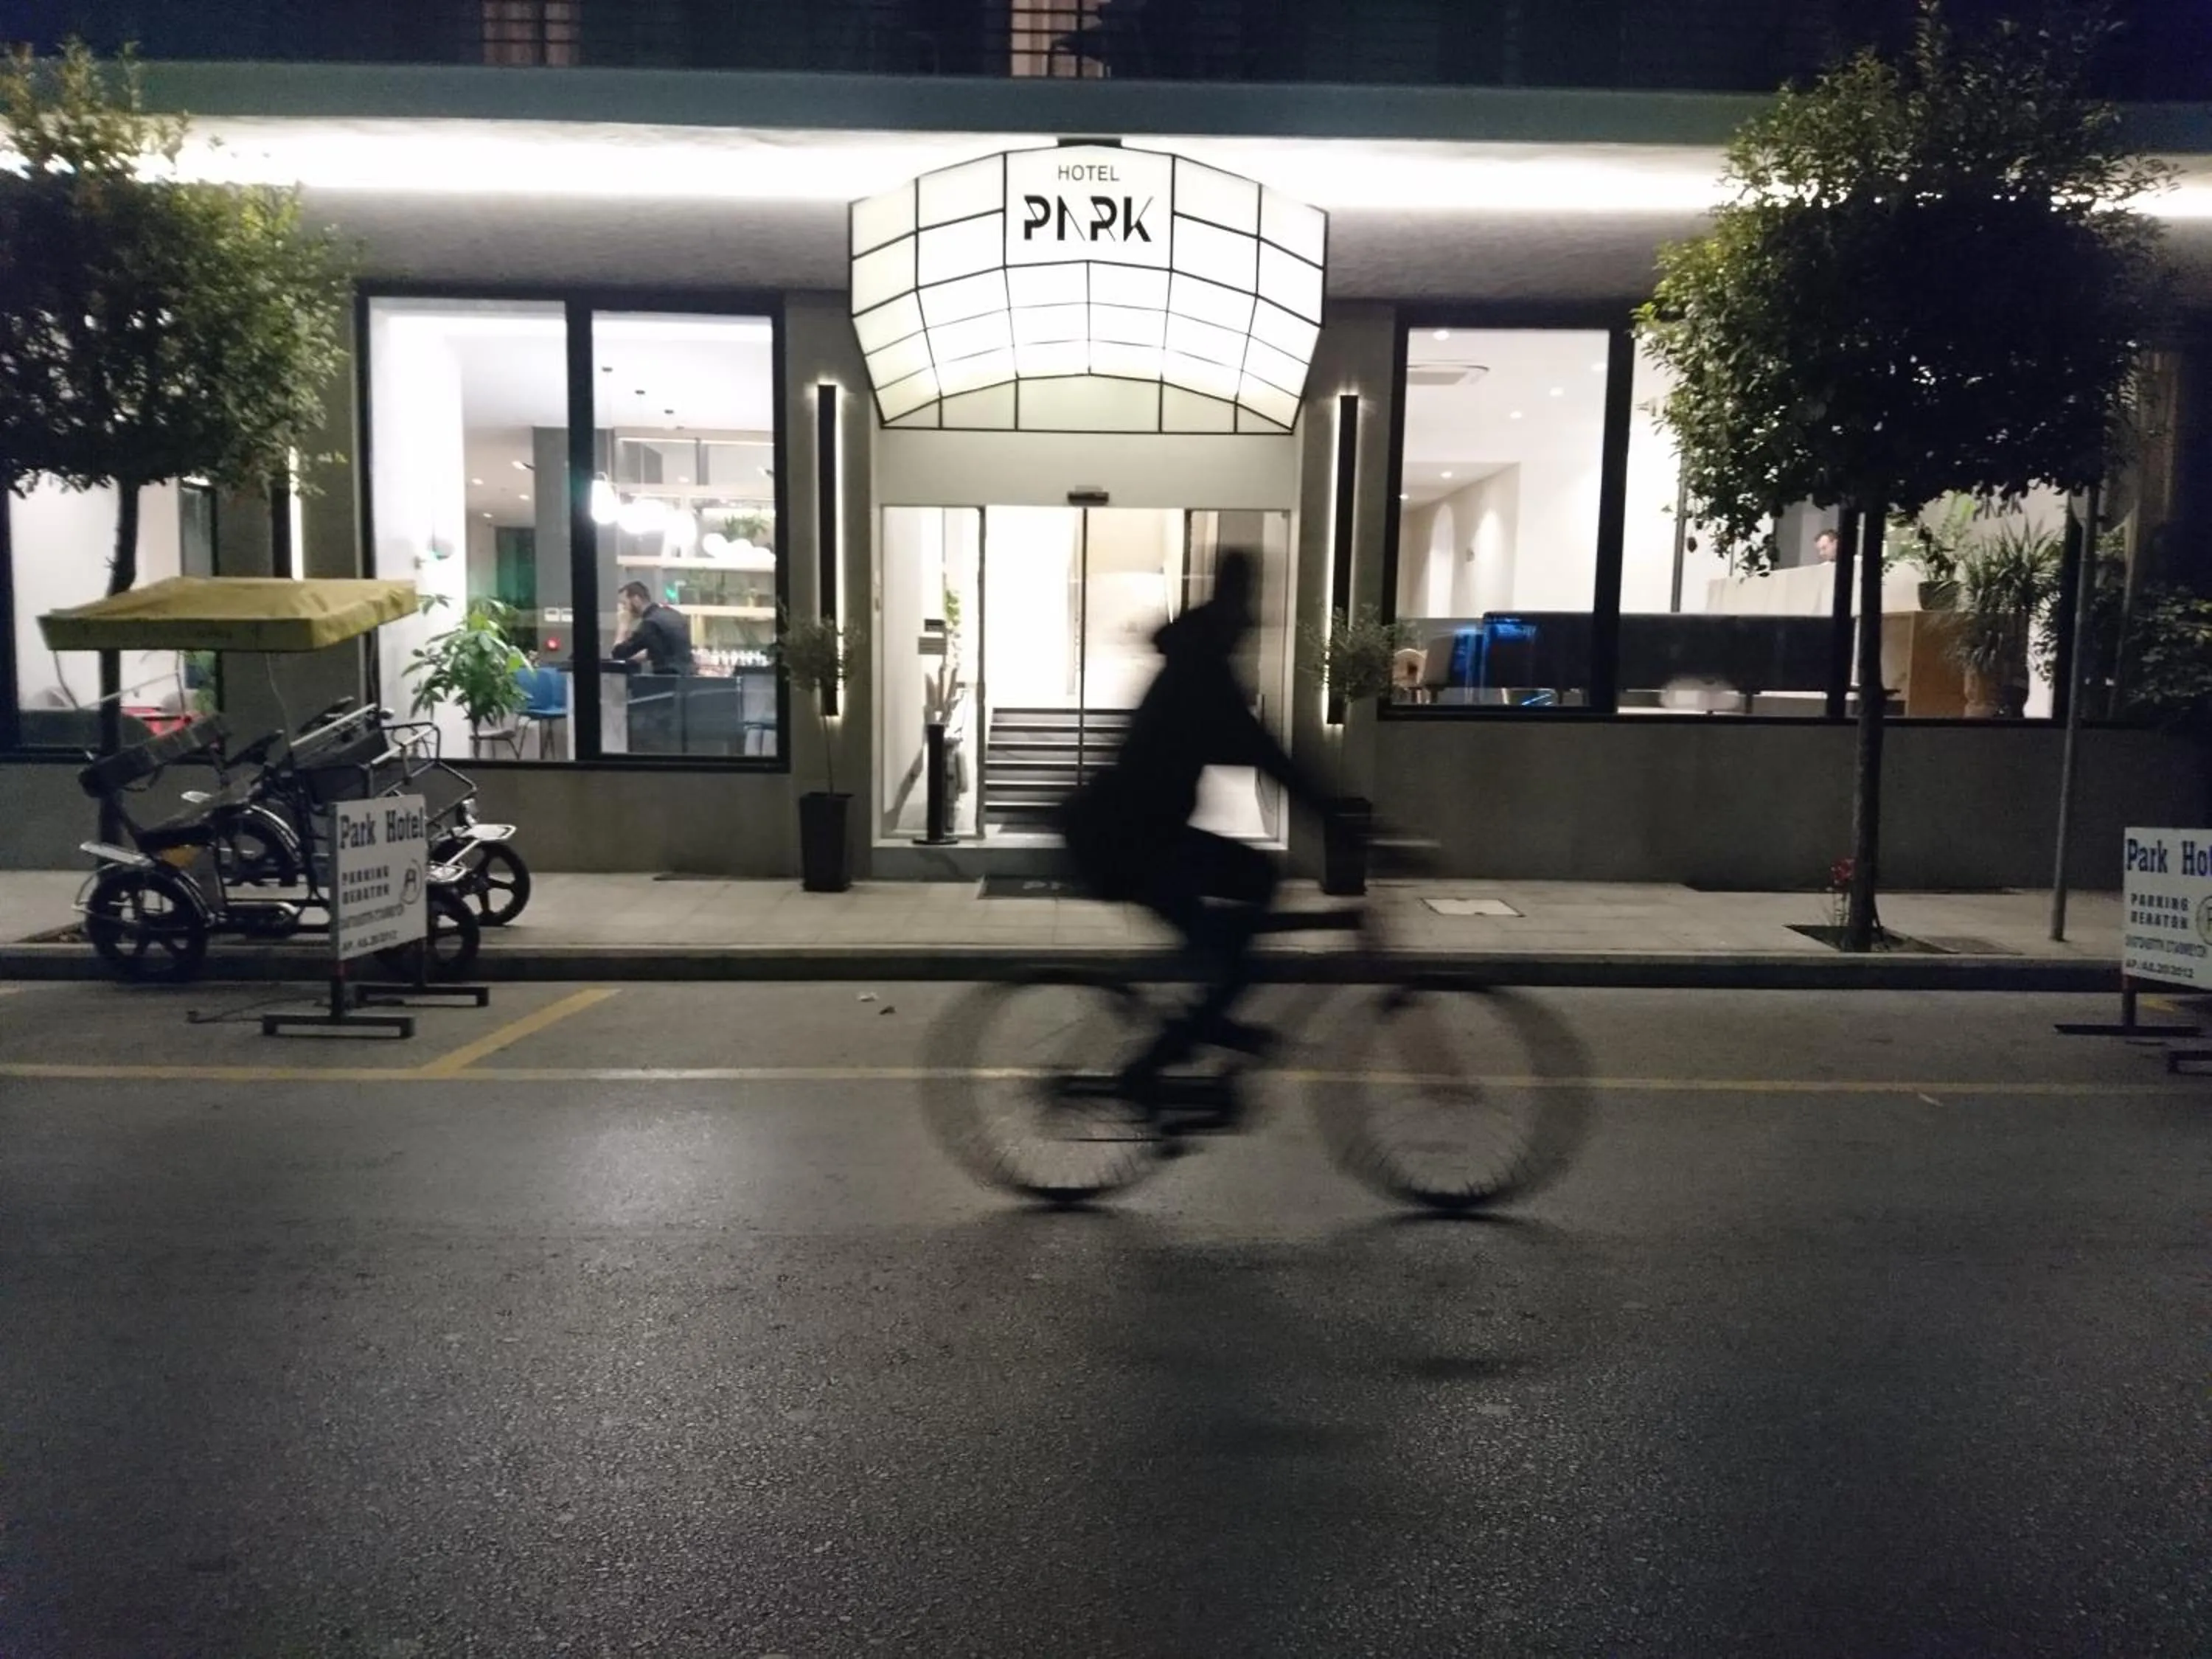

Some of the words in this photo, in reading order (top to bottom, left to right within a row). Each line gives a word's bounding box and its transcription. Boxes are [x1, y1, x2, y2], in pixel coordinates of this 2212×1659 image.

[1057, 164, 1120, 181] HOTEL
[1023, 195, 1154, 242] PARK
[339, 812, 376, 849] Park
[386, 807, 425, 844] Hotel
[2126, 838, 2168, 874] Park
[2181, 840, 2212, 877] Ho
[341, 865, 390, 886] PARKING
[2130, 892, 2189, 911] PARKING
